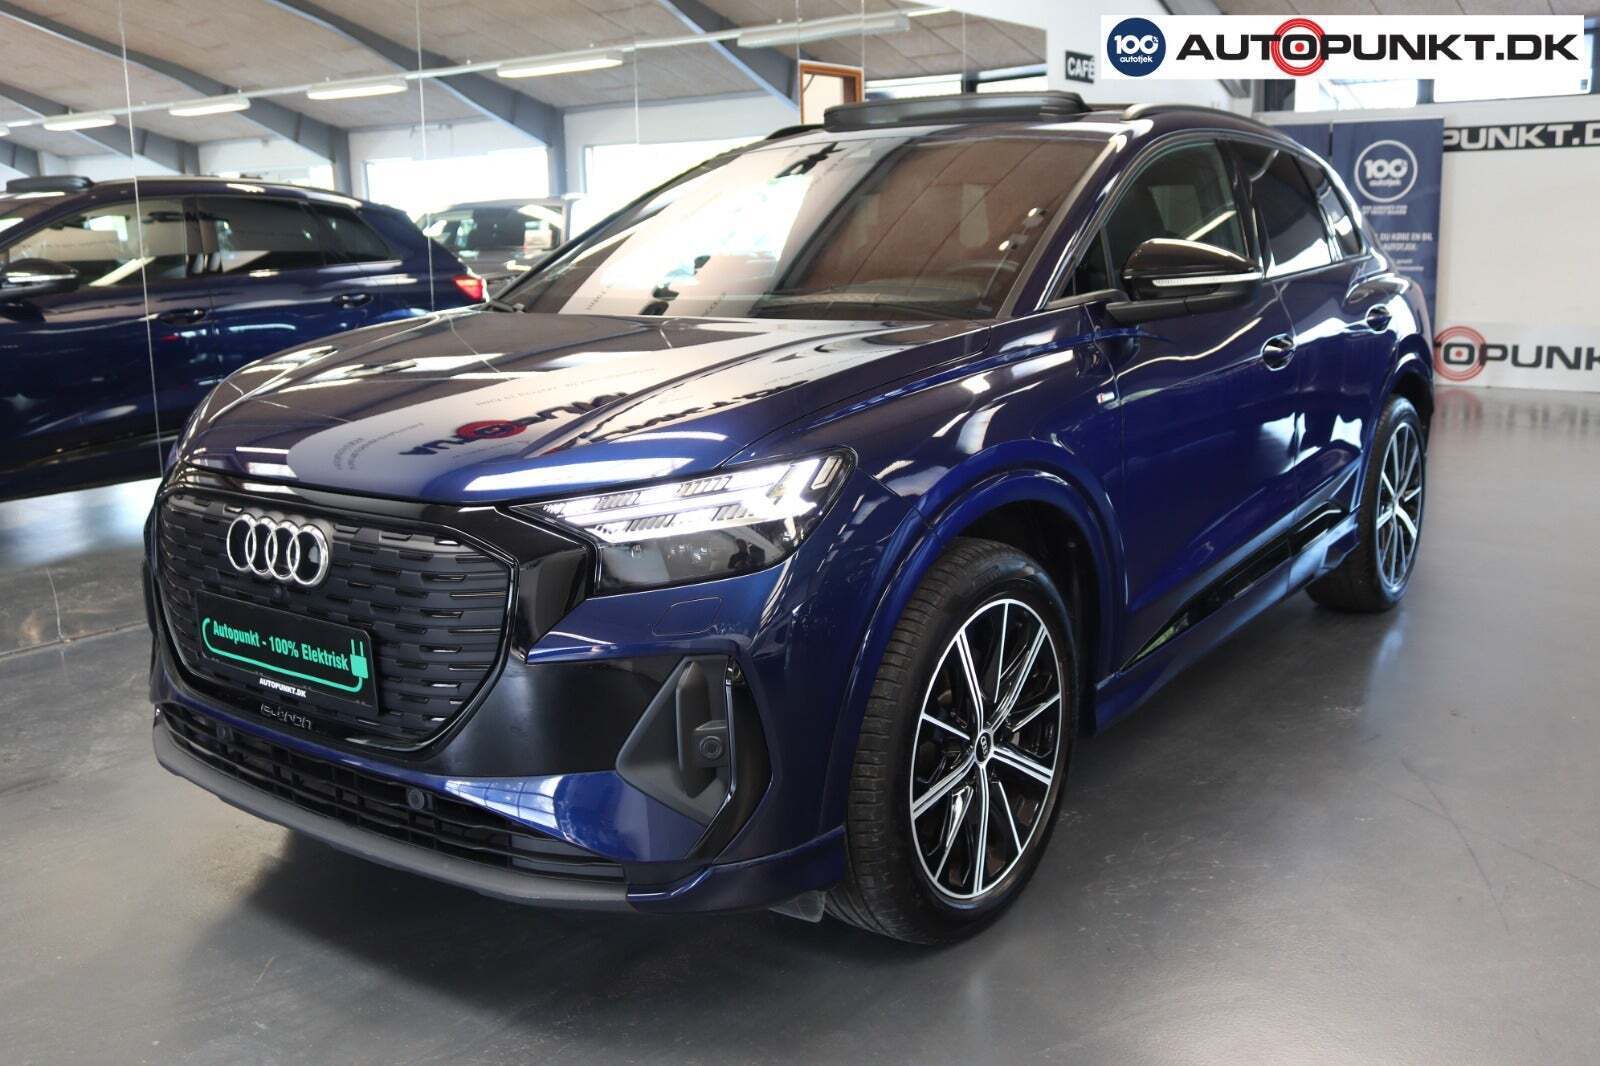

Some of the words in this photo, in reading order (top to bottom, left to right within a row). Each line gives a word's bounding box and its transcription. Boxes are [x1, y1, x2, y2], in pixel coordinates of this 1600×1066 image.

[1434, 340, 1600, 371] OPUN
[213, 620, 261, 648] Autopunkt
[269, 635, 299, 658] 100%
[301, 643, 350, 672] Elektrisk
[259, 677, 307, 699] AUTOPUNKT.DK
